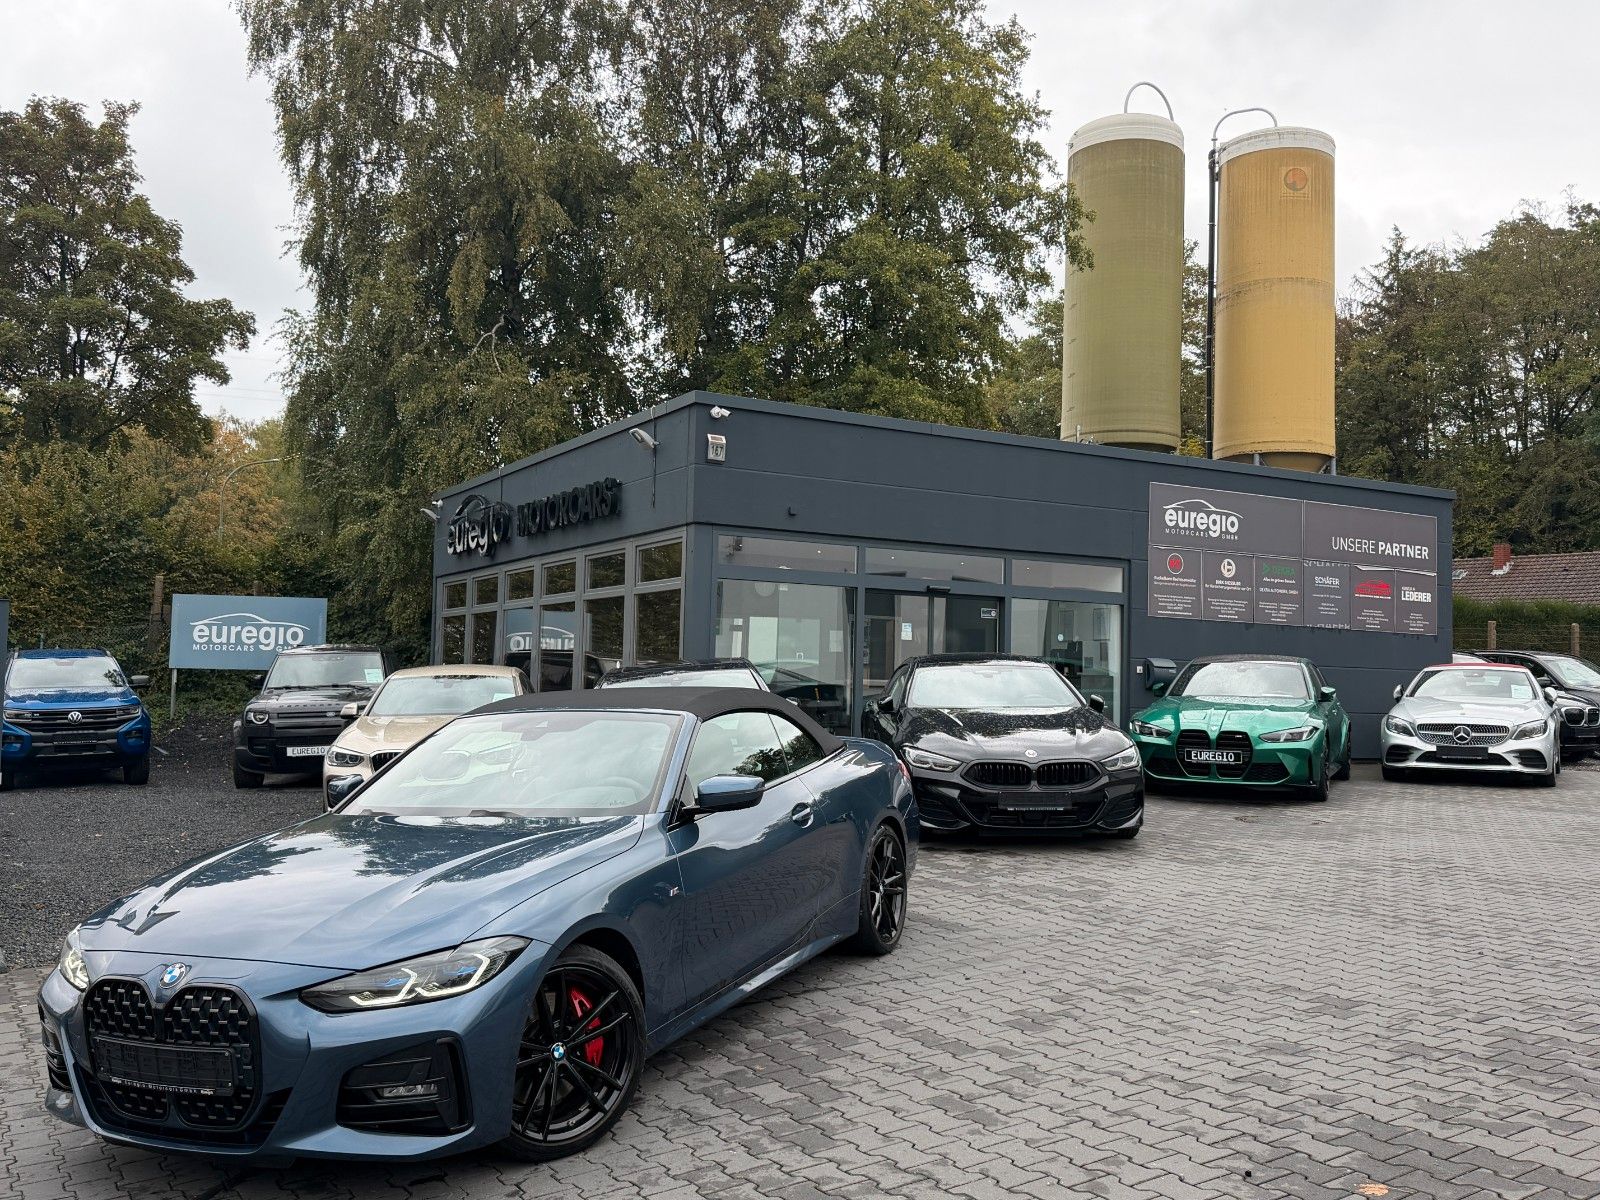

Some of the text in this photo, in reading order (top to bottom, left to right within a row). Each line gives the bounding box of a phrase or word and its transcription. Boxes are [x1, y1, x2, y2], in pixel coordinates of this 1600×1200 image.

[447, 477, 624, 557] euregio MOTORCARS
[1164, 508, 1239, 537] euregio
[1165, 528, 1209, 538] MOTORCARS
[1332, 536, 1429, 560] UNSERE PARTNER
[1314, 576, 1340, 586] SCHÄFER
[1401, 590, 1432, 603] LEDERER
[192, 624, 304, 651] euregio
[192, 643, 255, 652] MOTORCARS
[291, 747, 326, 755] EUREGIO
[1191, 750, 1235, 762] EUREGIO
